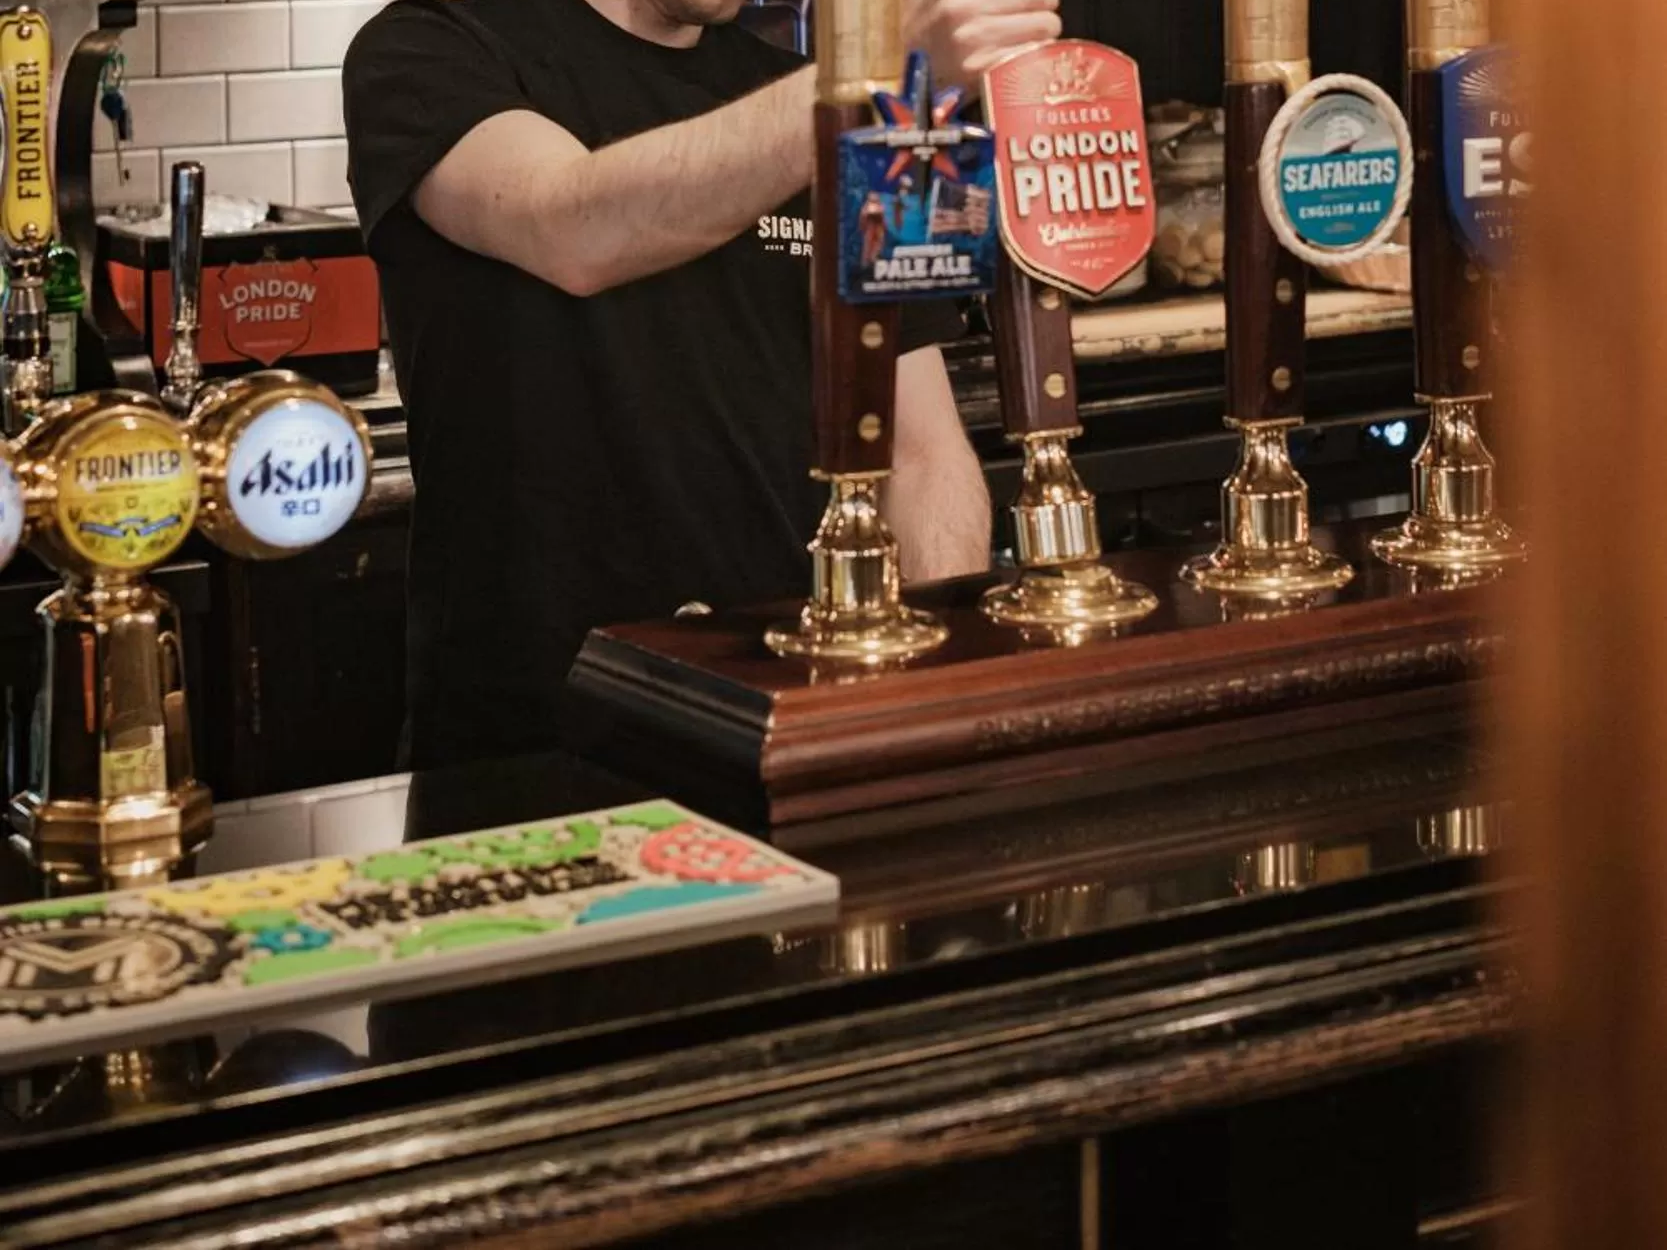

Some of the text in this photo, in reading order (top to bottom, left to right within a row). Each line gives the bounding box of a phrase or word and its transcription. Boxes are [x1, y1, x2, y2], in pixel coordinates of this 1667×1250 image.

[16, 60, 42, 200] FRONTIER
[1489, 110, 1530, 127] FUL
[1009, 130, 1139, 163] LONDON
[1014, 160, 1147, 218] PRIDE
[1283, 156, 1397, 193] SEAFARERS
[1299, 200, 1381, 220] ENGLISH ALE
[874, 255, 972, 281] PALE ALE
[218, 278, 317, 310] LONDON
[235, 302, 301, 324] PRIDE
[74, 448, 182, 483] FRONTIER
[240, 437, 355, 498] Asahi
